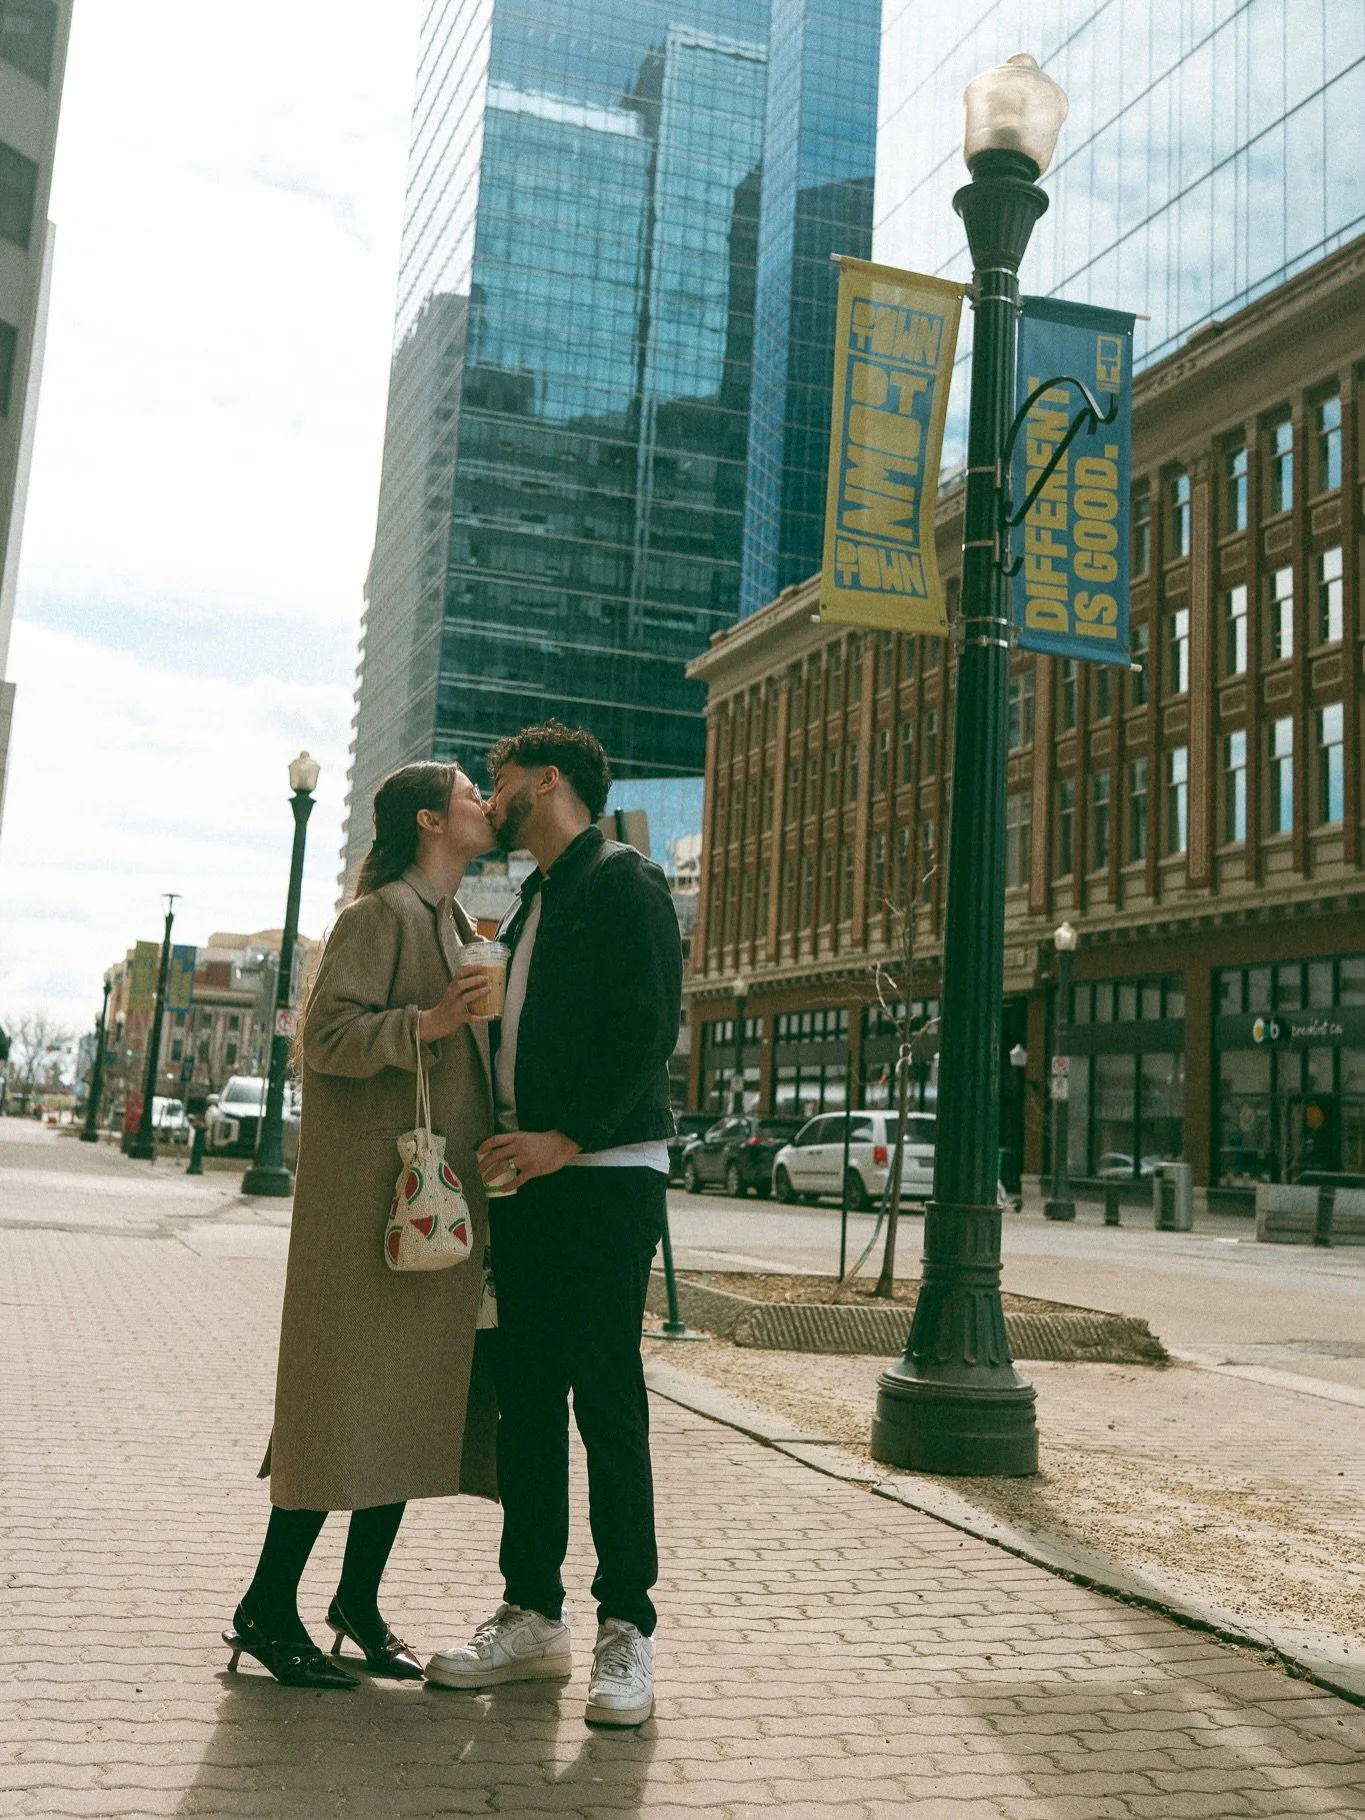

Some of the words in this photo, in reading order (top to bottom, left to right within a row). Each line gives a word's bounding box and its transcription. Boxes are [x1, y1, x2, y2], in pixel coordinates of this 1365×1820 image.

[1024, 376, 1070, 633] DIFFERENT
[1073, 444, 1119, 583] GOOD.
[1074, 591, 1118, 640] IS
